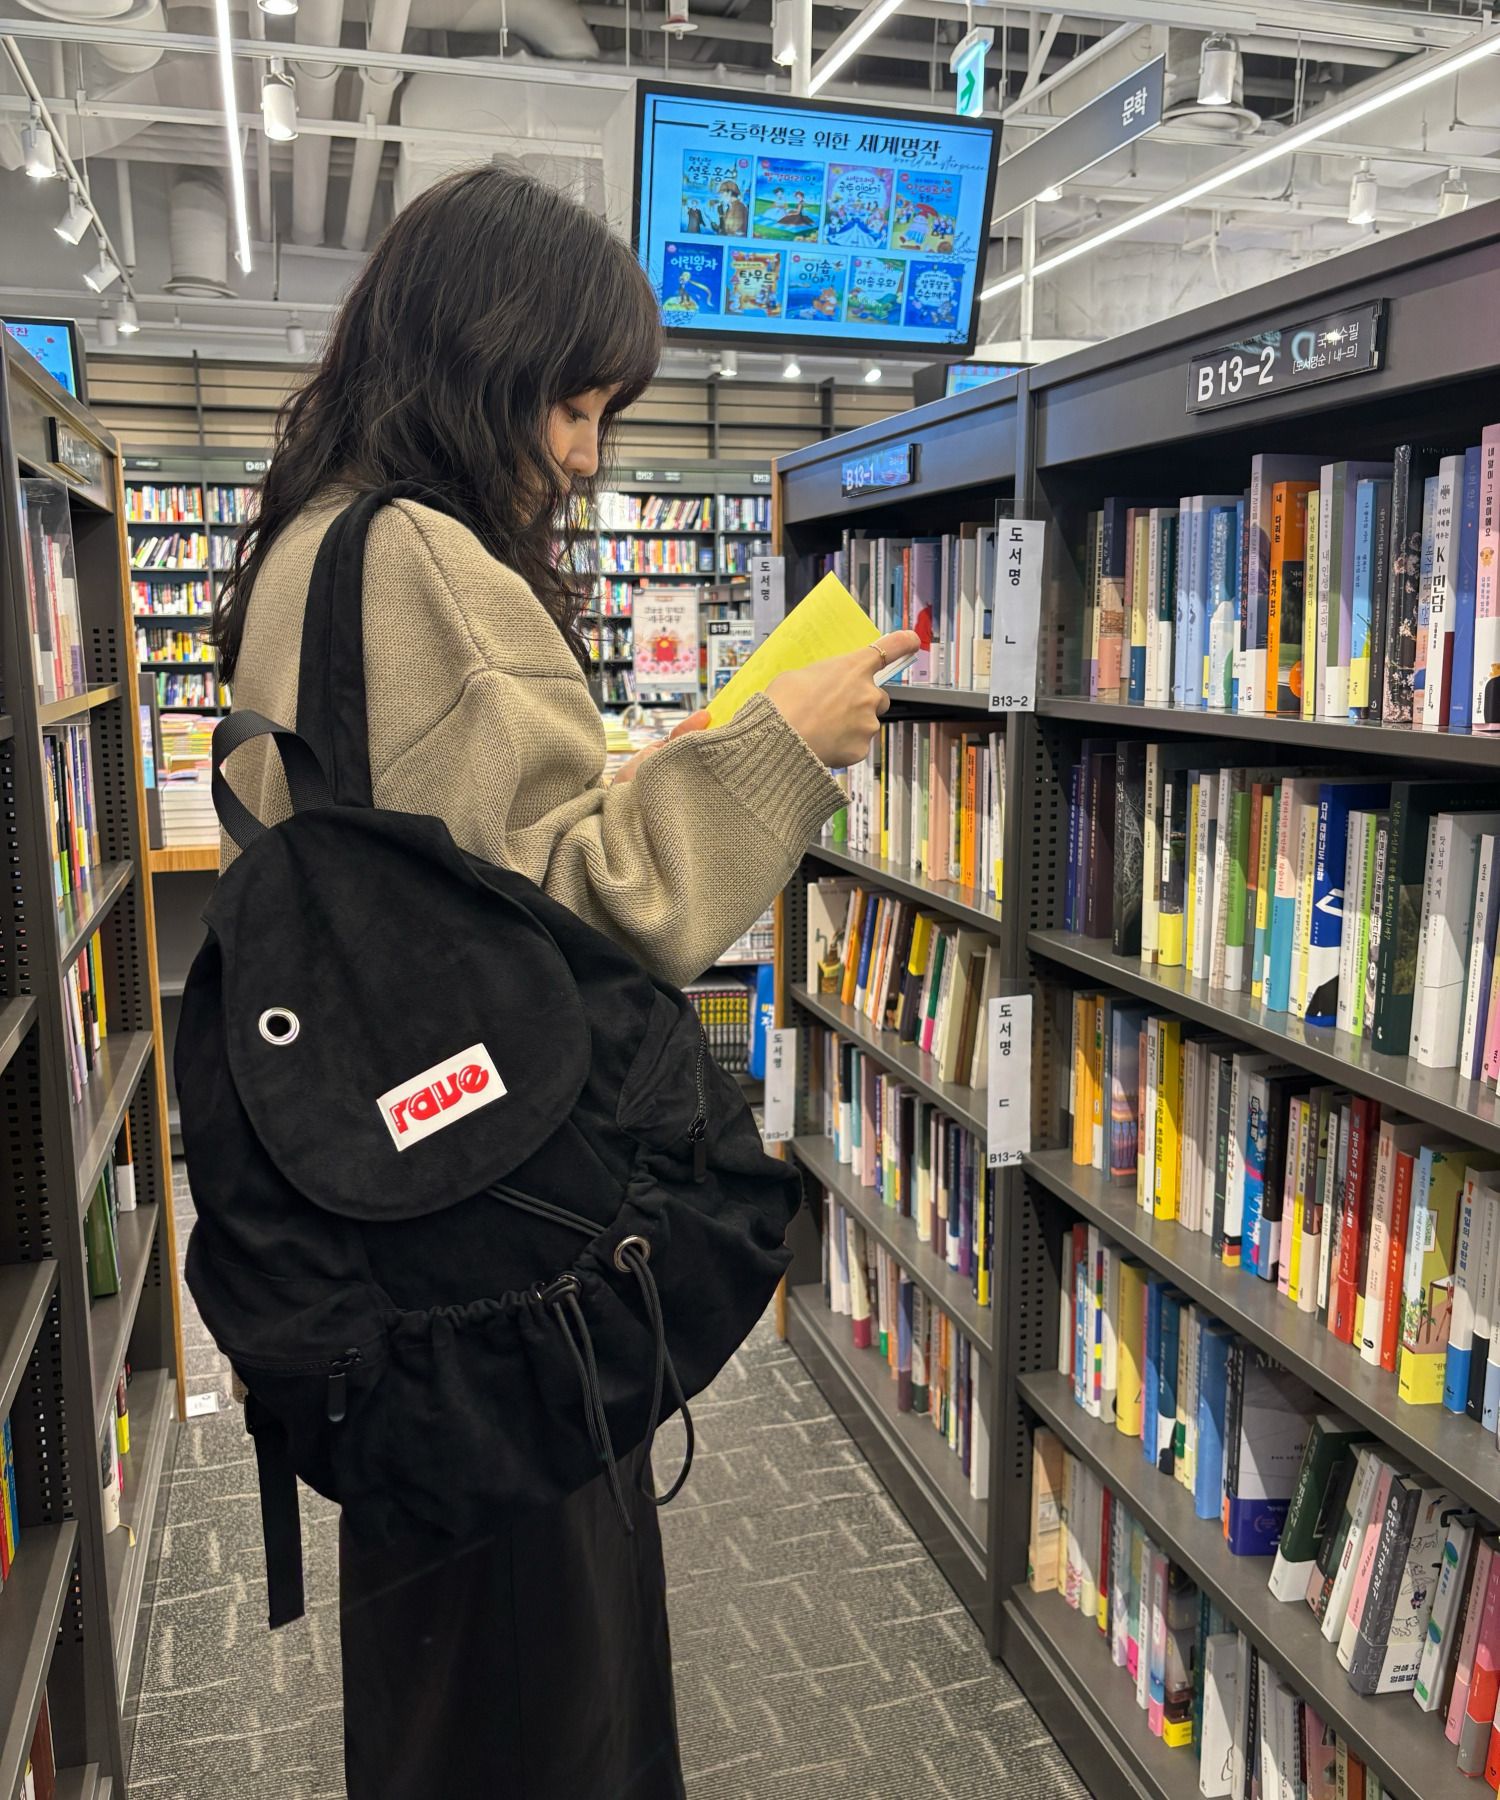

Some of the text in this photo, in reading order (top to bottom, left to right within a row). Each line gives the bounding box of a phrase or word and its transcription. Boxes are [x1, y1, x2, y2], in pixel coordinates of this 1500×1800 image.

[1121, 87, 1148, 126] 문학
[709, 119, 942, 160] 초등학생을 위한 세계명작
[670, 255, 719, 271] 어린왕자
[739, 269, 774, 286] 탈무드
[804, 259, 832, 274] 이솝
[1198, 346, 1275, 402] B13-2
[846, 461, 874, 491] B13-1
[1009, 527, 1024, 586] 도서명
[992, 695, 1029, 707] B13-2
[999, 1004, 1013, 1056] 도서명
